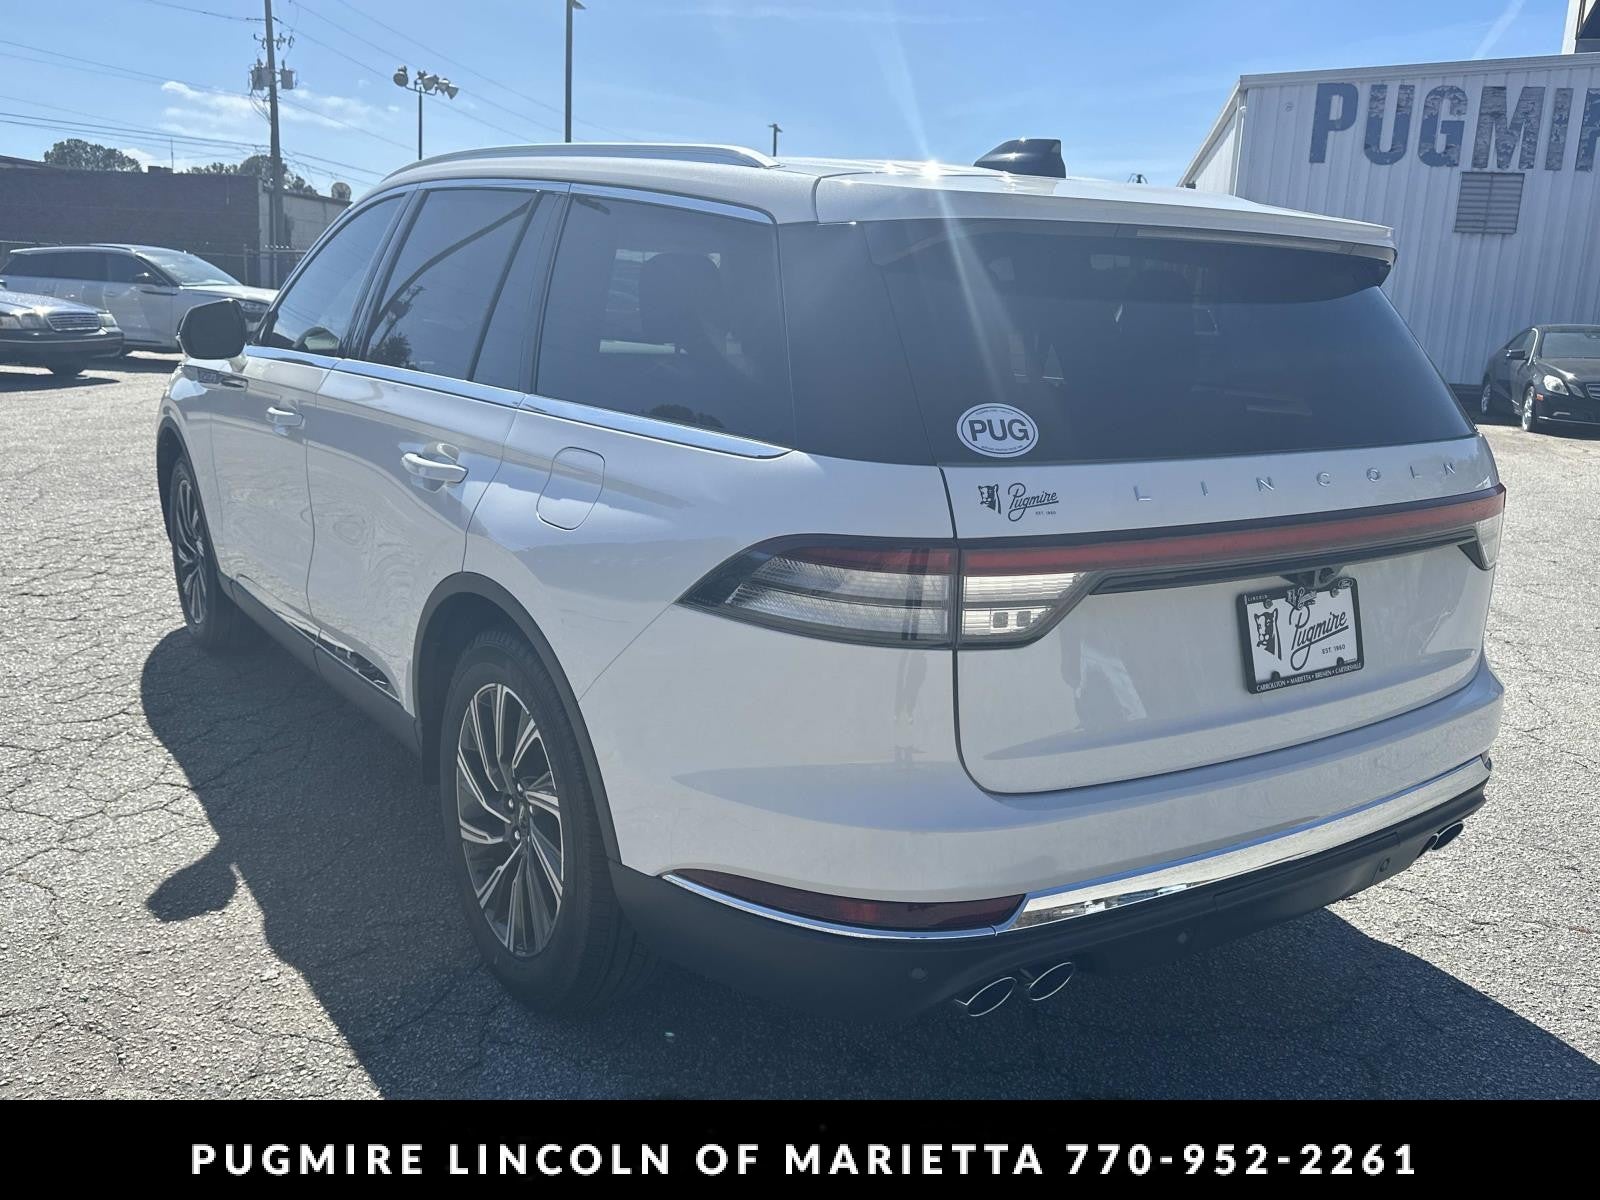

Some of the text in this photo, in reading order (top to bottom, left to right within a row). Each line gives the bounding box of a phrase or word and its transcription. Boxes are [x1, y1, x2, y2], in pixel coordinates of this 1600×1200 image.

[968, 419, 1030, 441] PUG
[1133, 461, 1456, 502] LINCOLN
[1008, 482, 1059, 522] Pugmire
[1288, 604, 1349, 671] Pugmire
